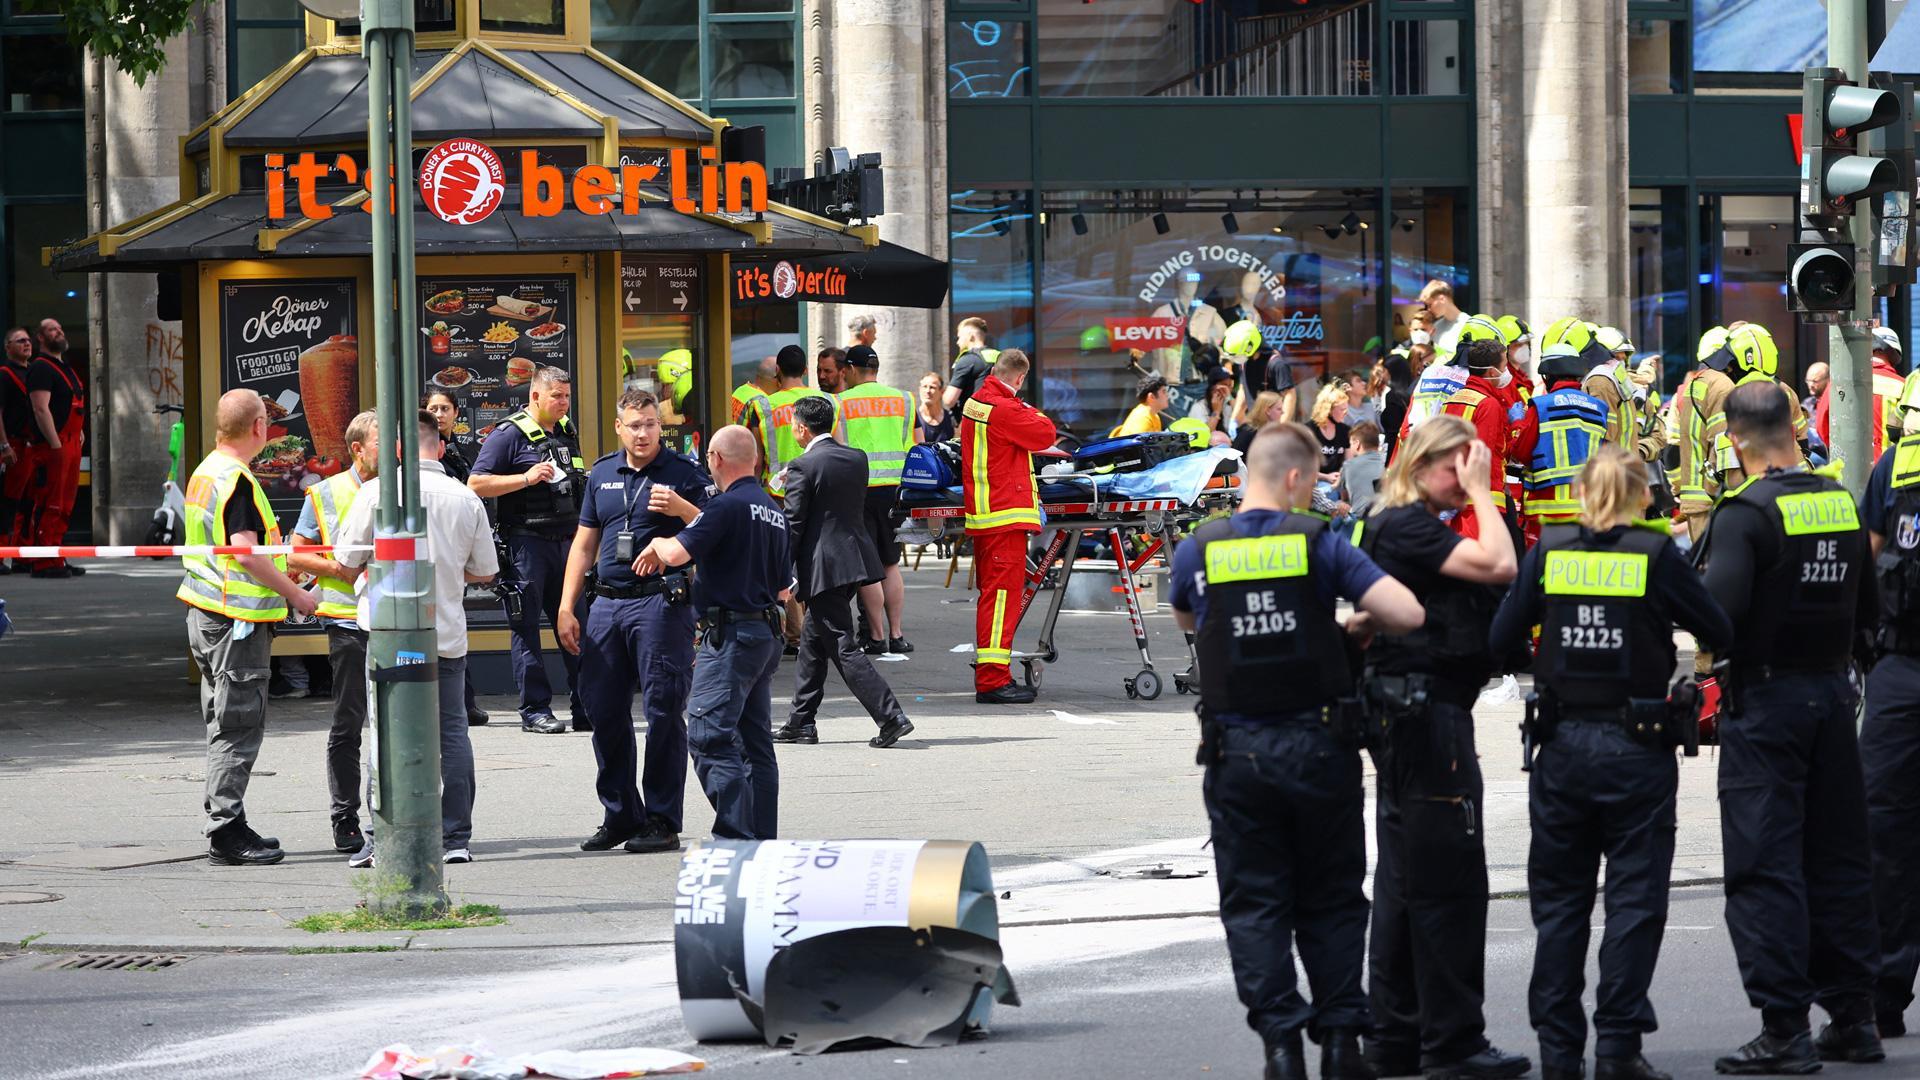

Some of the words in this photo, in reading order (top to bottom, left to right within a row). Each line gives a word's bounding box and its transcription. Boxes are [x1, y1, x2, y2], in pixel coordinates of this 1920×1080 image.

[421, 154, 441, 189] DÖNER
[440, 148, 449, 157] &
[450, 142, 502, 180] CURRYWURST
[520, 146, 768, 216] berlin
[1809, 205, 1819, 214] F1
[621, 266, 647, 278] BHOLEN
[659, 266, 698, 278] BESTELLEN
[736, 266, 771, 300] it's
[796, 264, 847, 295] berlin
[1139, 250, 1195, 304] RIDING
[1197, 245, 1287, 302] TOGETHER
[272, 296, 329, 317] Döner
[242, 308, 321, 343] Kebap
[241, 357, 268, 370] FOOD
[269, 354, 281, 366] TO
[283, 350, 297, 363] GO
[250, 363, 292, 377] DELICIOUS
[929, 508, 958, 517] BERLINER
[1037, 538, 1061, 576] FEUERWEHR
[1212, 542, 1302, 575] POLIZEI
[1817, 540, 1838, 560] BE
[1550, 559, 1641, 588] POLIZEI
[1801, 562, 1848, 582] 32117
[1246, 590, 1277, 613] BE
[1231, 611, 1297, 637] 32105
[1577, 604, 1606, 626] BE
[1561, 626, 1624, 649] 32125
[884, 875, 900, 909] ORT
